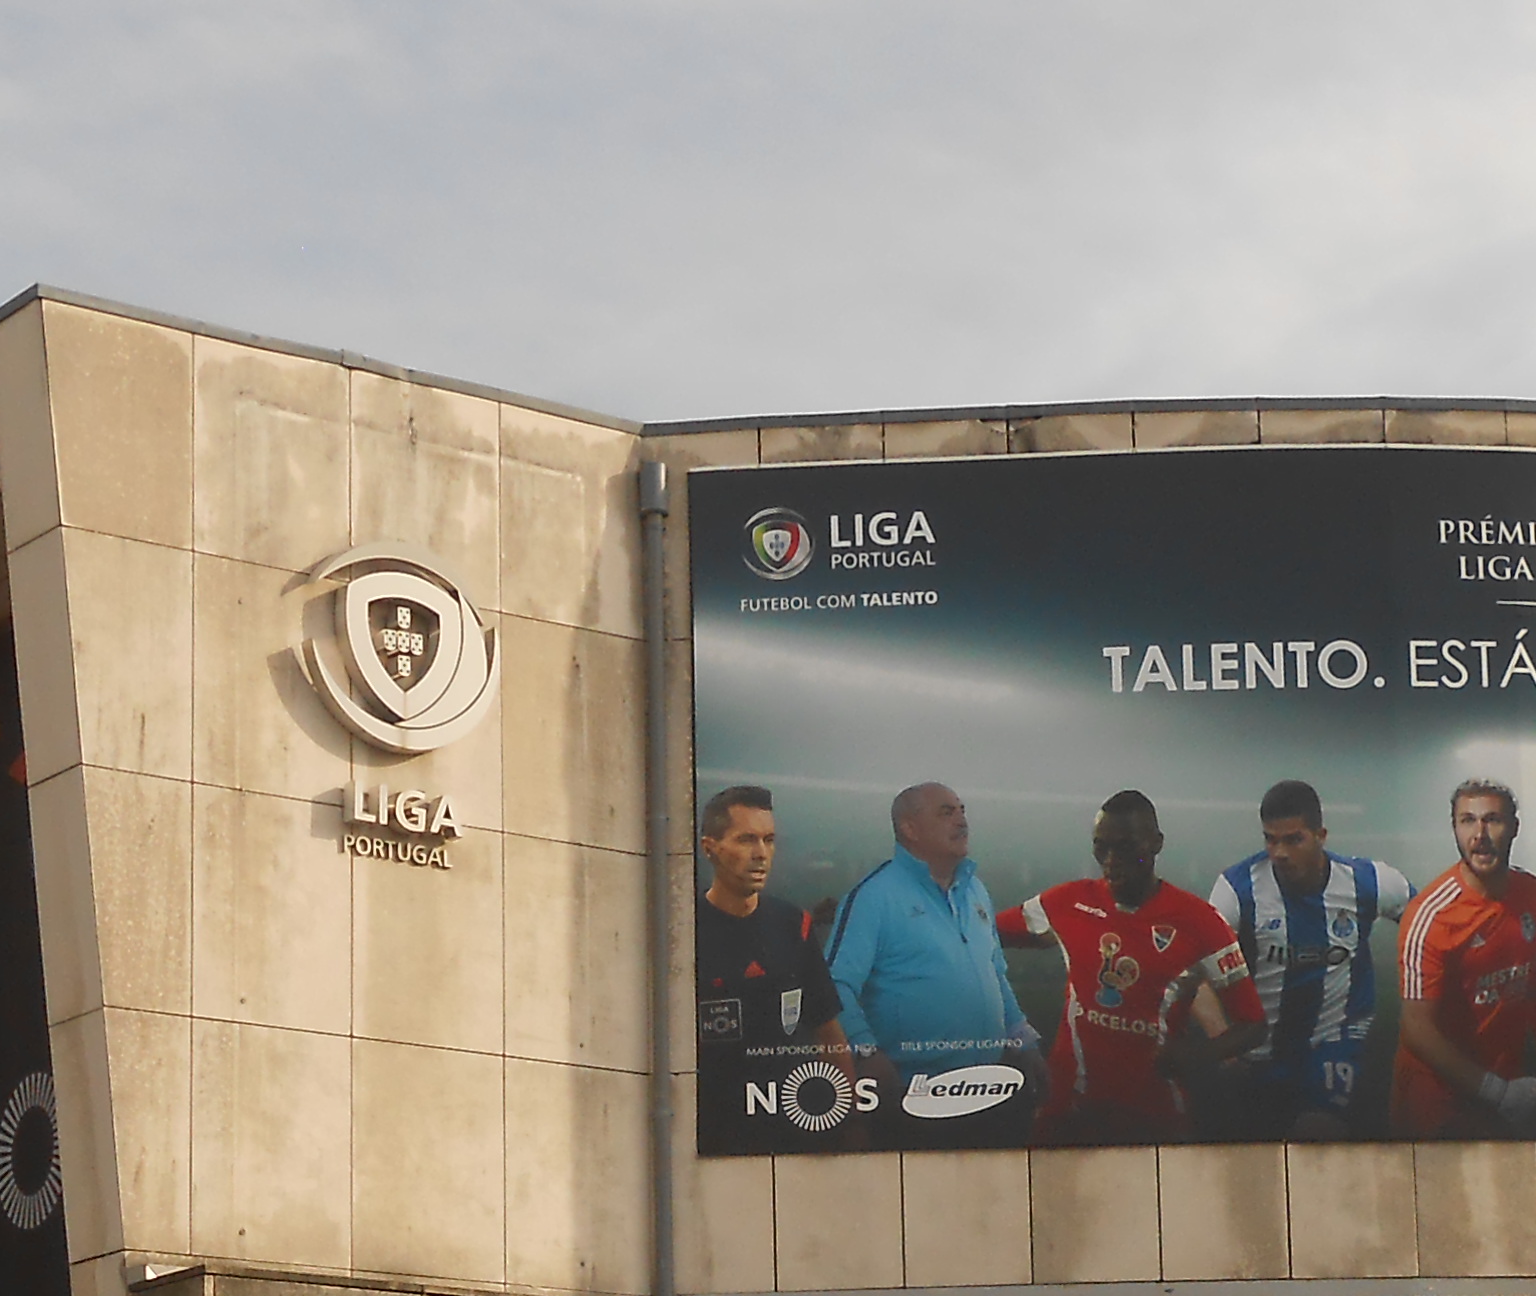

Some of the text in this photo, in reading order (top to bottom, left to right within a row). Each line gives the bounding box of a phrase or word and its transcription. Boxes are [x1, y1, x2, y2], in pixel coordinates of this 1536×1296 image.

[830, 510, 938, 549] LIGA
[831, 550, 938, 570] PORTUGAL
[1458, 556, 1534, 582] LIGA
[740, 590, 939, 613] FUTEBOL COM TALENTO
[1103, 640, 1386, 692] TALENTO.
[354, 779, 463, 838] LIGA
[344, 833, 454, 868] PORTUGAL
[746, 1046, 775, 1057] MAIN
[776, 1044, 826, 1057] SPONSOR
[827, 1043, 852, 1055] LIGA
[900, 1037, 1024, 1051] TITLE SPONSOR LIGAPRO
[908, 1073, 1020, 1098] Ledman
[1323, 1060, 1354, 1093] 19
